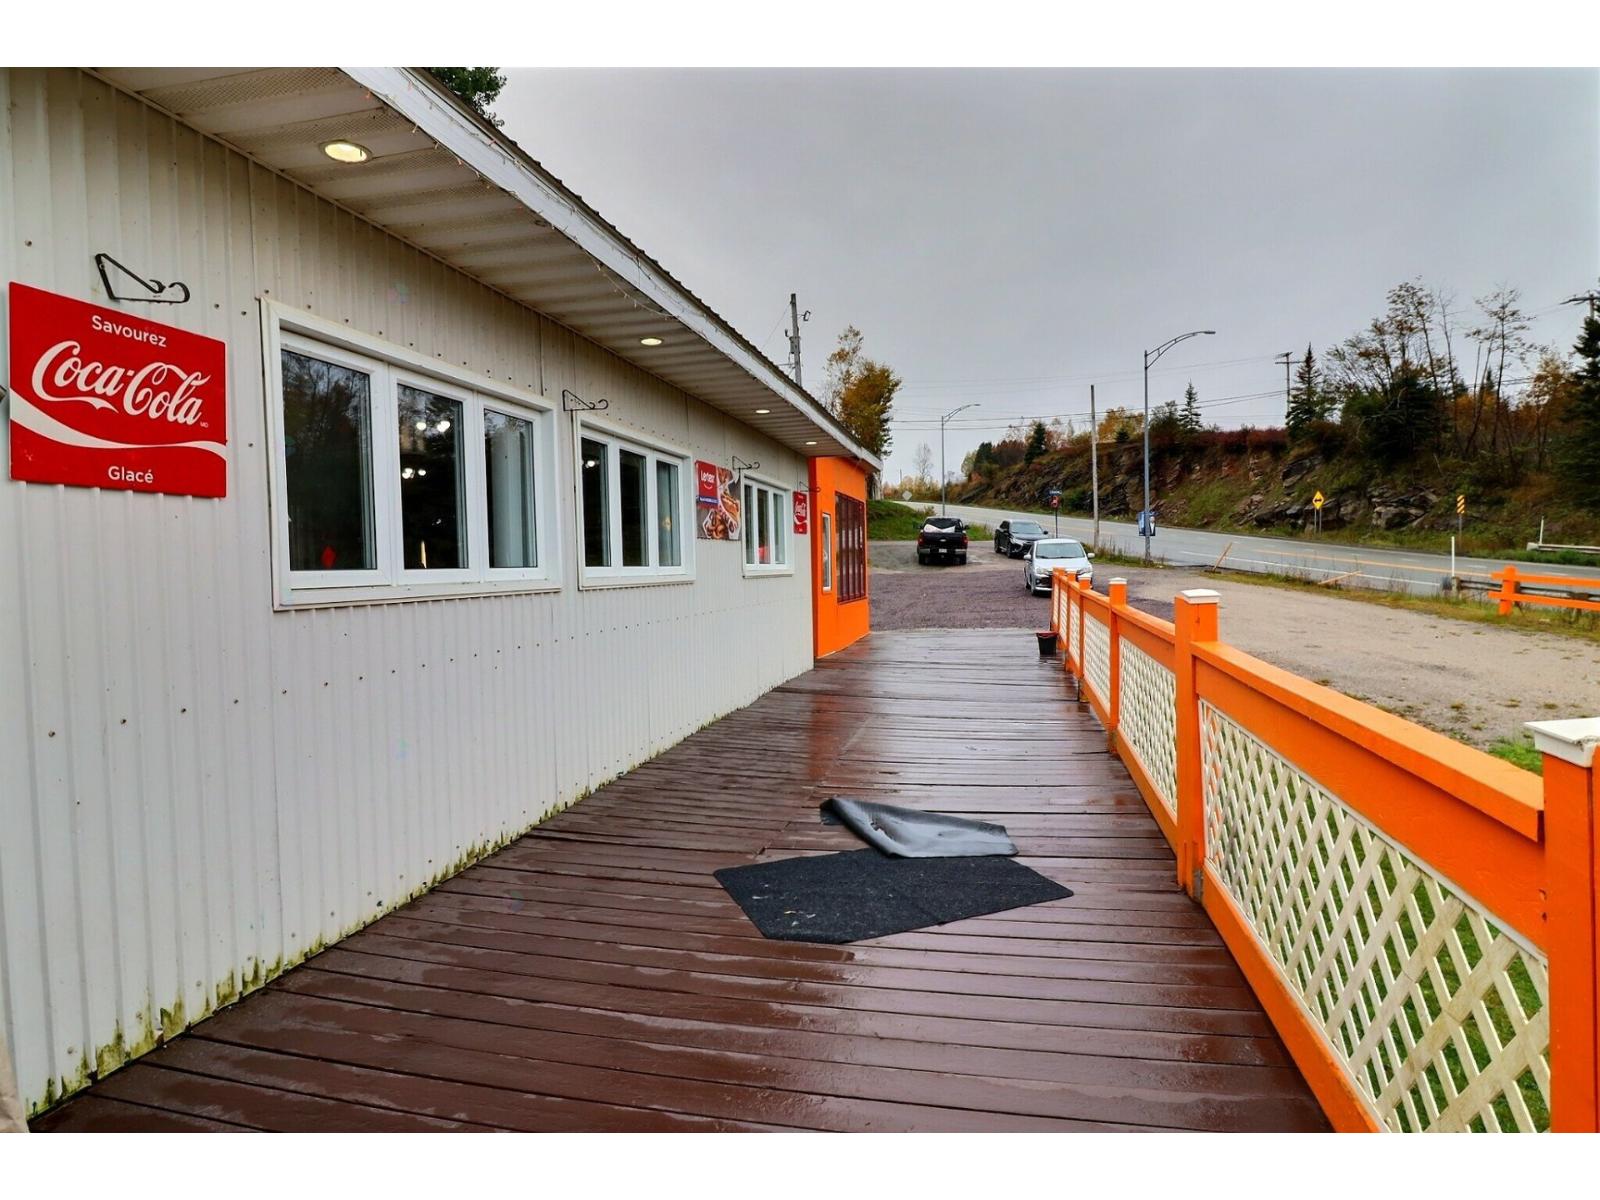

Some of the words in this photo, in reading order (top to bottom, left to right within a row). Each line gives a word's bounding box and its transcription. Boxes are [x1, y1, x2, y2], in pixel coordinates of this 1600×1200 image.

[91, 315, 167, 347] Savourez
[32, 340, 211, 426] Coca-Cola
[108, 466, 154, 484] Glacé
